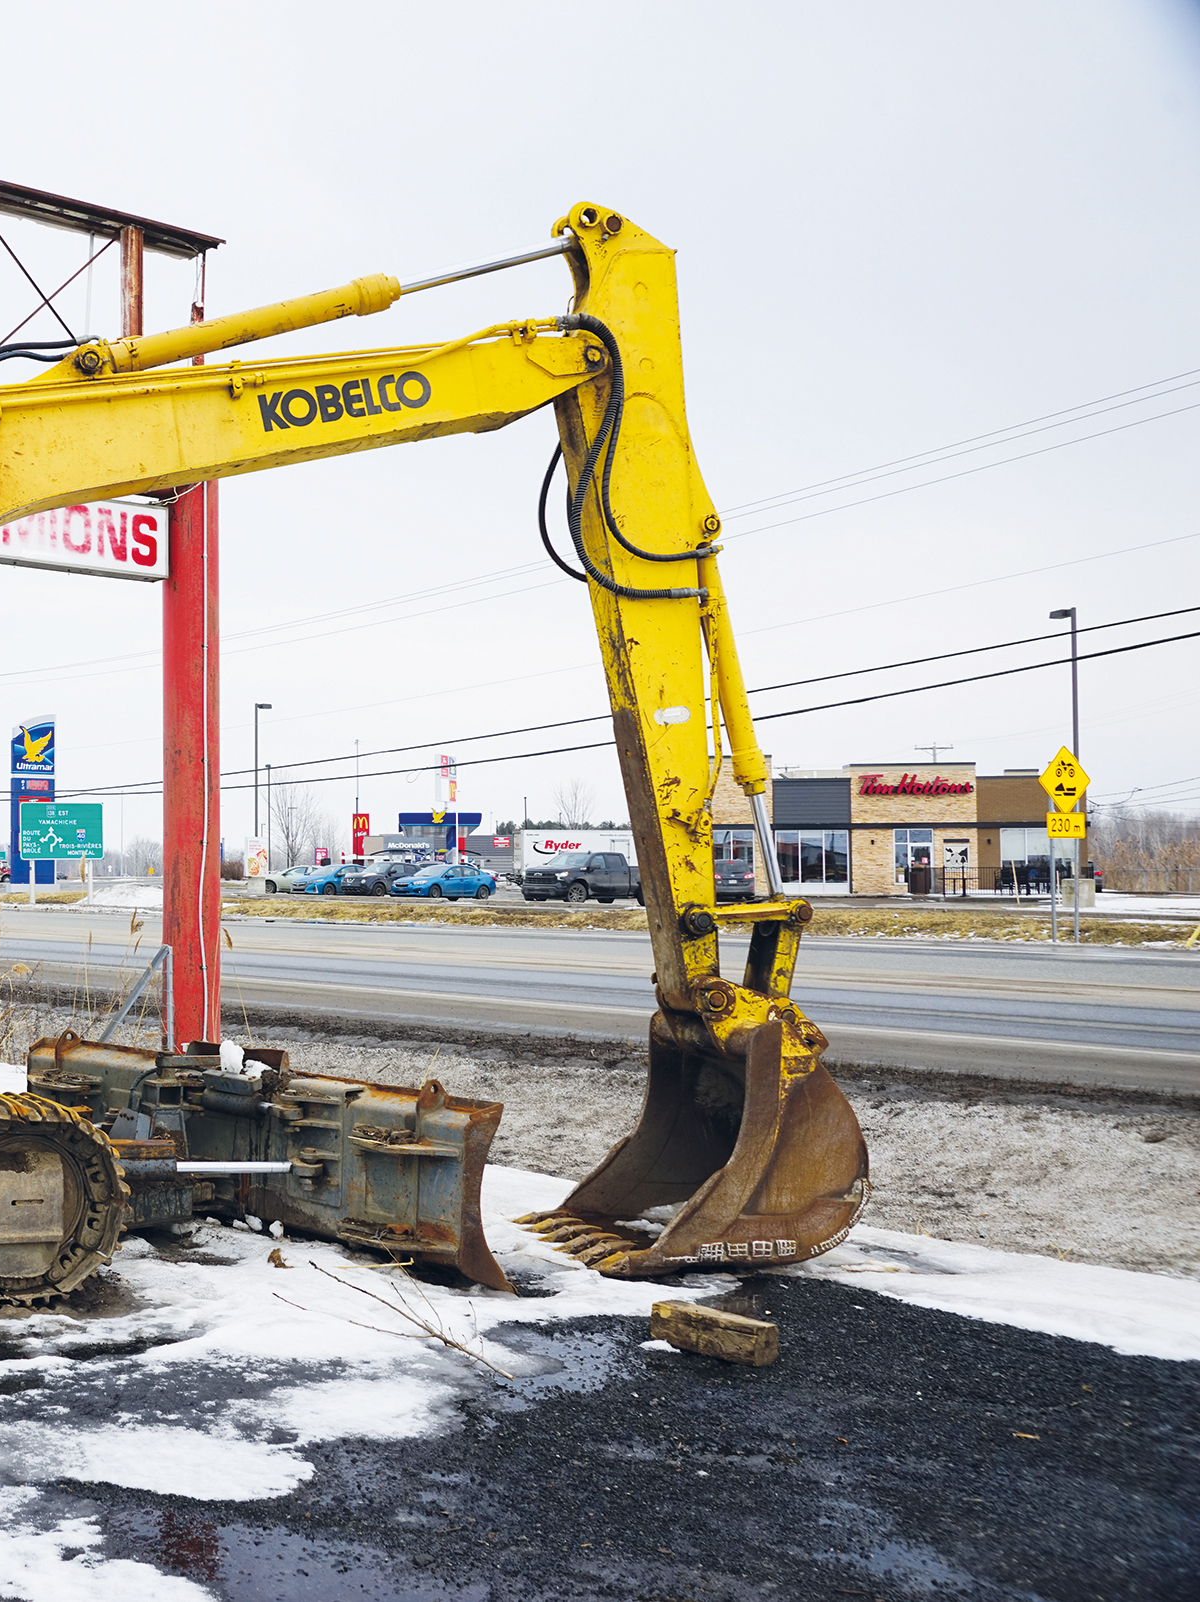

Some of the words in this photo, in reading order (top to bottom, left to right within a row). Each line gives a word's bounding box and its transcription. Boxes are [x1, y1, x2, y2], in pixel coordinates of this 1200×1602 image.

[257, 371, 432, 432] KOBELCO
[16, 762, 54, 771] Ultramar
[858, 774, 894, 795] Tim
[896, 772, 971, 795] Hortons
[1051, 818, 1071, 832] 230
[544, 840, 582, 851] Ryder
